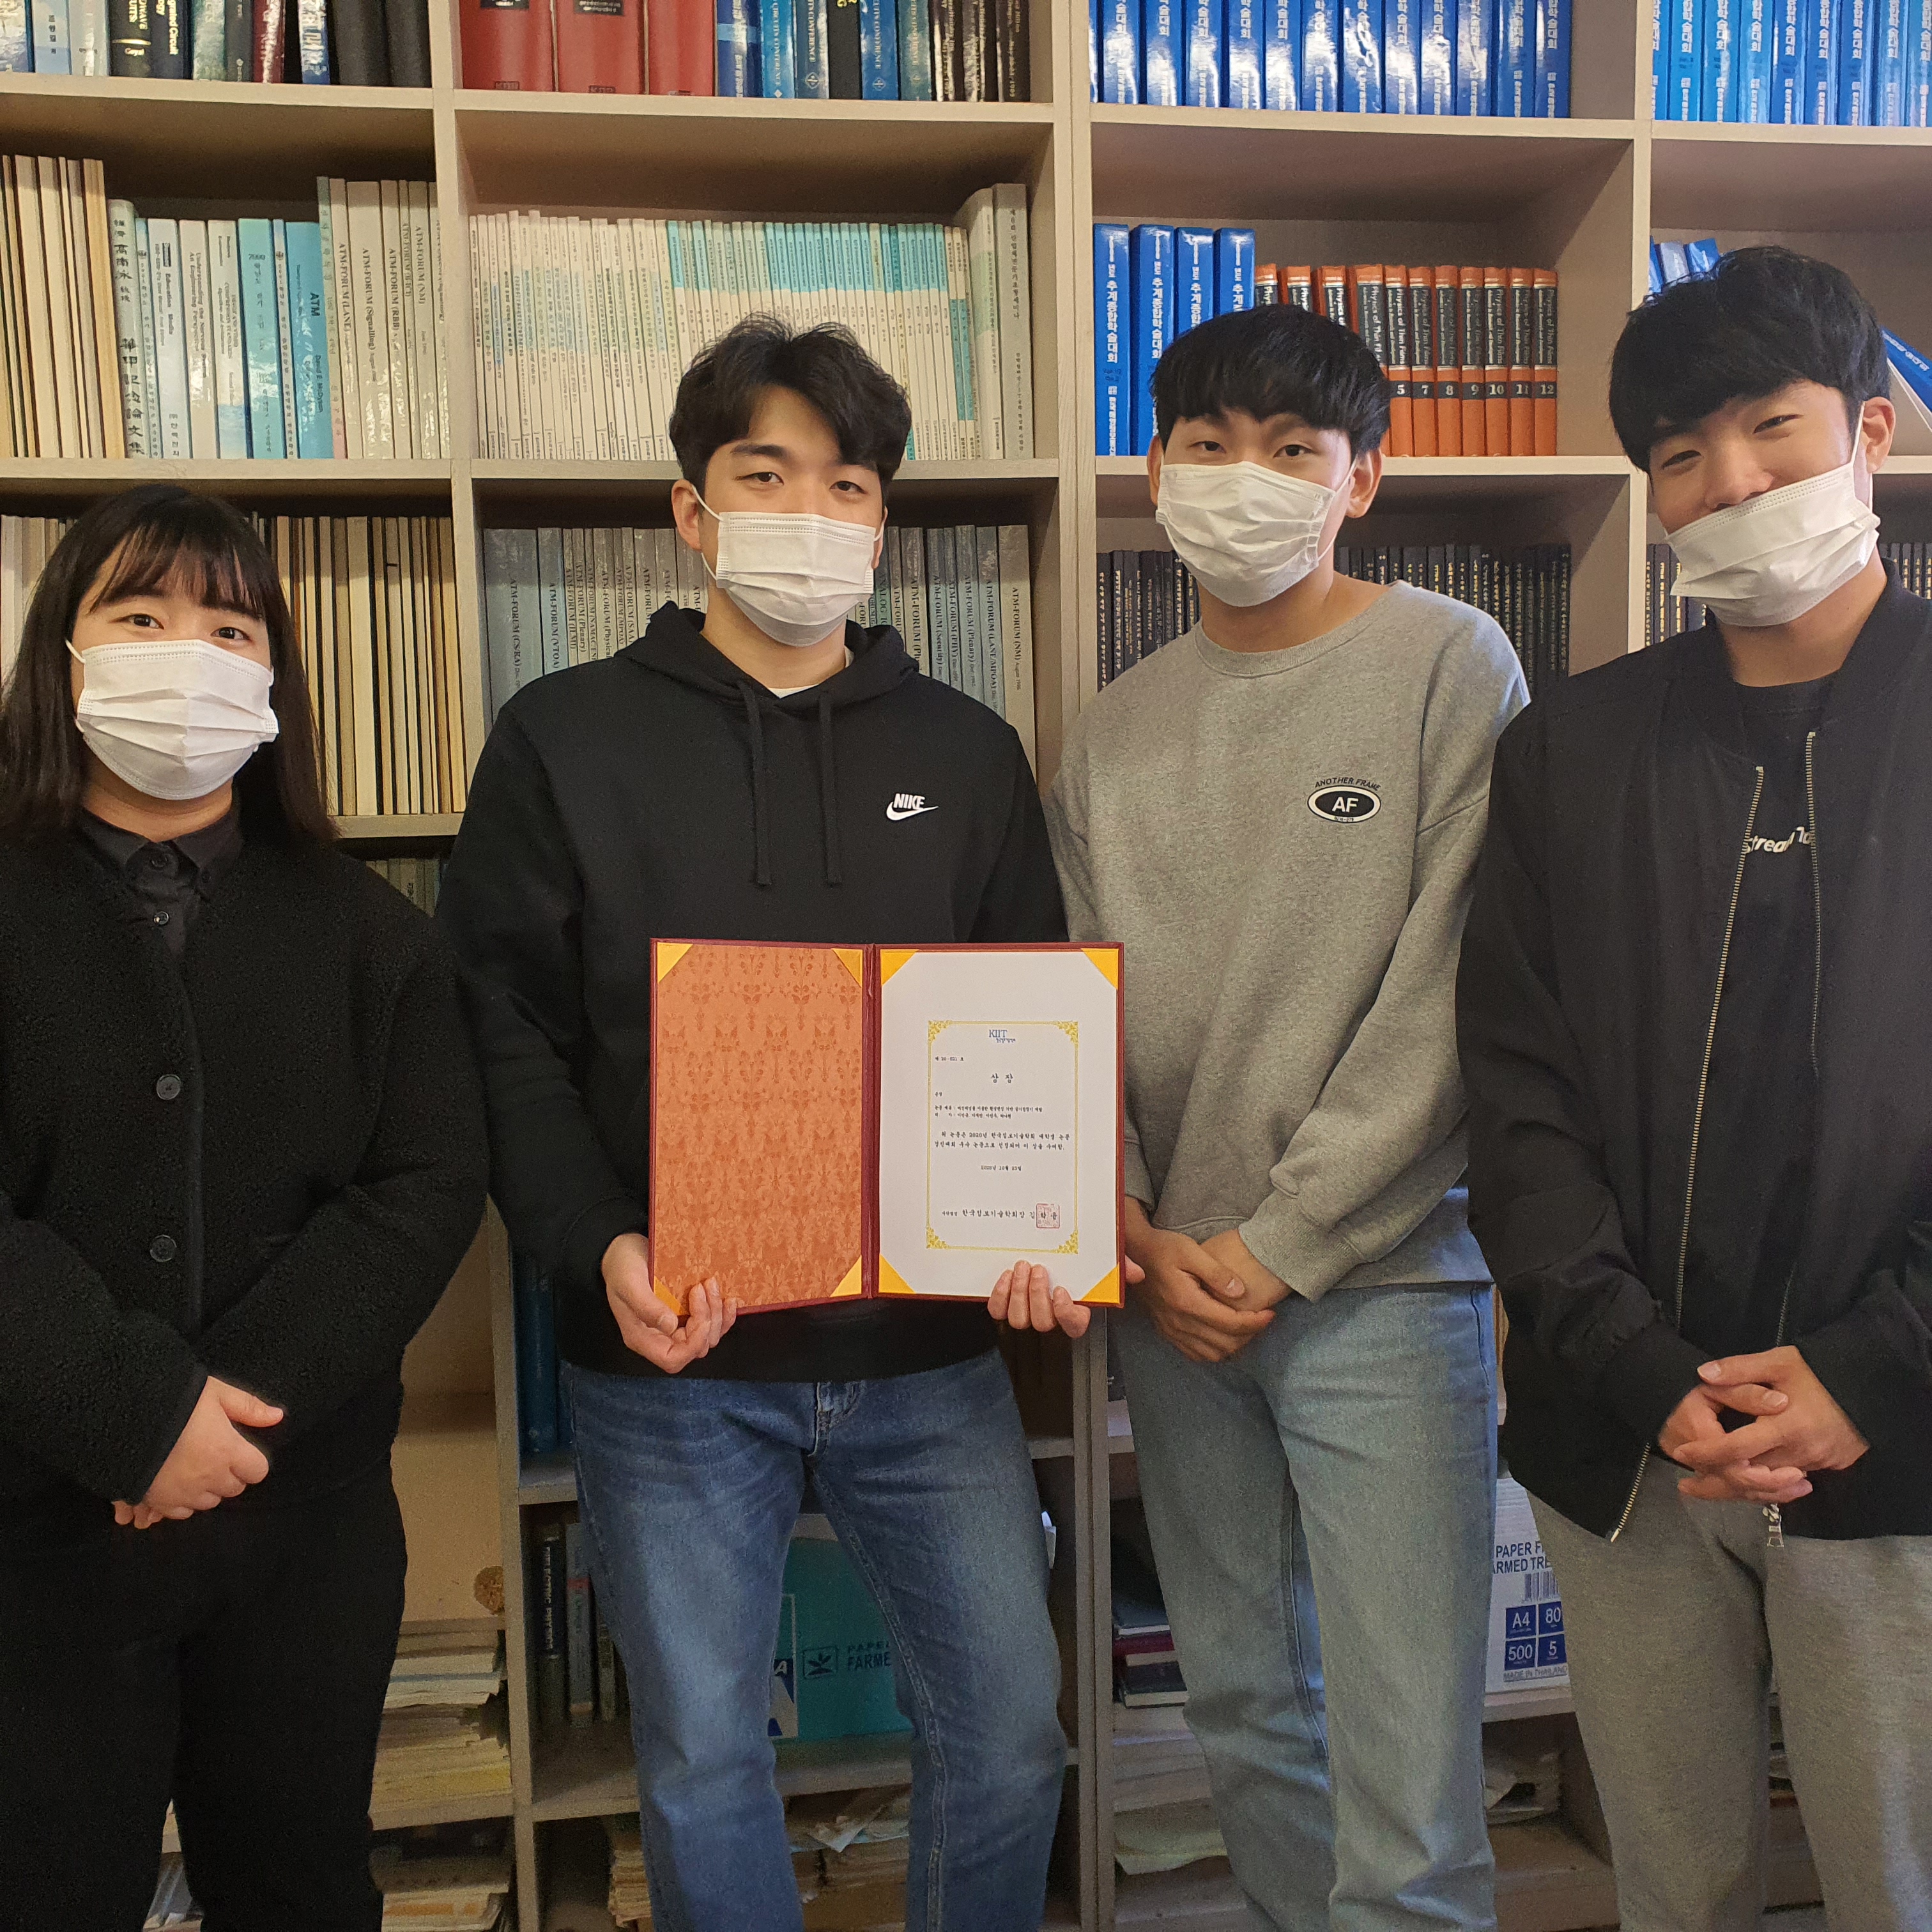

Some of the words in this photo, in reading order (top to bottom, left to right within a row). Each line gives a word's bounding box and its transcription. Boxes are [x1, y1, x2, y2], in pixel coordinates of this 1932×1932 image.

[169, 27, 180, 55] Circuit
[873, 21, 882, 70] CONFERENCE
[190, 252, 195, 261] An
[415, 226, 427, 282] ATM-FORUM
[195, 252, 204, 305] Understanding
[339, 242, 350, 300] ATM-FORUM
[362, 248, 373, 304] ATM-FORUM
[388, 249, 400, 305] ATM-FORUM
[310, 293, 321, 316] ATM
[417, 283, 427, 304] (NM)
[1335, 288, 1345, 316] Physics
[1370, 286, 1379, 314] Physics
[1396, 288, 1405, 316] Physics
[1420, 289, 1429, 317] Physics
[1495, 289, 1504, 316] Physics
[1546, 289, 1554, 316] Physics
[365, 307, 377, 350] (Signalling)
[390, 307, 401, 330] (RBB)
[1373, 314, 1381, 324] of
[1397, 318, 1406, 326] of
[1422, 318, 1430, 326] of
[1496, 318, 1505, 326] of
[1546, 318, 1554, 326] of
[1398, 328, 1406, 344] Thin
[314, 355, 323, 373] David
[1399, 346, 1407, 365] Films
[1497, 346, 1505, 364] Films
[1396, 385, 1405, 395] 5
[1421, 385, 1429, 395] 7
[1445, 385, 1454, 395] 8
[1471, 385, 1478, 395] 9
[1489, 385, 1505, 395] 10
[1515, 384, 1529, 395] 11
[1540, 385, 1554, 395] 12
[566, 568, 575, 622] ATM-FORUM
[576, 564, 585, 615] ATM-FORUM
[587, 567, 595, 614] ATM-FORUM
[601, 569, 611, 624] ATM-FORUM
[625, 565, 634, 618] ATM-FORUM
[878, 571, 888, 613] ANALOG
[933, 575, 943, 628] ATM-FORUM
[964, 574, 974, 627] ATM-FORUM
[509, 578, 519, 631] ATM-FORUM
[548, 582, 558, 635] ATM-FORUM
[910, 579, 921, 641] ATM-FORUM
[948, 580, 958, 632] ATM-FORUM
[985, 580, 995, 632] ATM-FORUM
[1011, 586, 1021, 639] ATM-FORUM
[578, 617, 587, 652] (Plenary)
[935, 629, 944, 665] (Security)
[950, 634, 959, 658] (PHY)
[966, 629, 976, 663] (Plenary)
[551, 636, 560, 668] (VTOA)
[1013, 641, 1022, 661] (NM)
[1314, 777, 1354, 788] ANOTHER
[1355, 778, 1381, 791] FRAME
[893, 793, 926, 810] NIKE
[1331, 796, 1359, 813] AF
[988, 1029, 1008, 1038] KIIT
[991, 1073, 999, 1084] 상
[1005, 1073, 1013, 1084] 장
[1496, 1541, 1532, 1558] PAPER
[544, 1607, 553, 1650] PHYSICS
[1512, 1612, 1531, 1629] A4
[1545, 1607, 1561, 1624] 80
[1508, 1644, 1533, 1662] 500
[1549, 1640, 1558, 1656] 5
[1503, 1669, 1524, 1682] MADE
[1535, 1666, 1568, 1678] THAILAND
